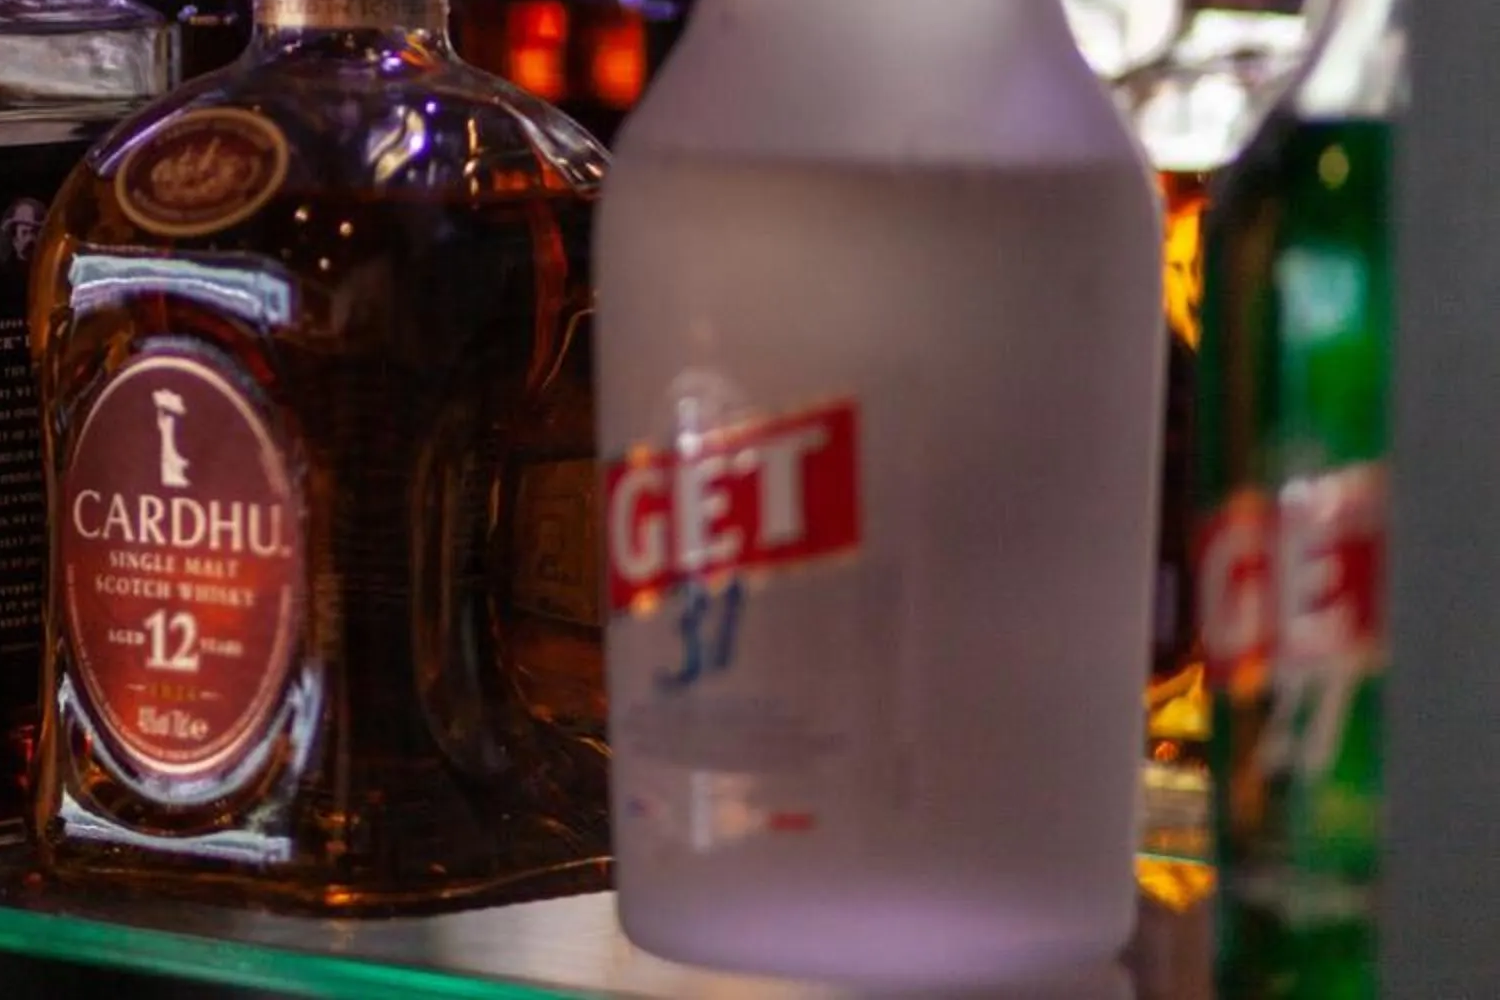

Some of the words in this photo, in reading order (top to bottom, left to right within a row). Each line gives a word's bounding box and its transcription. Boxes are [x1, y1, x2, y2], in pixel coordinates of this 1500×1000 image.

[73, 489, 283, 557] CARDHU
[612, 423, 831, 581] GET
[95, 574, 171, 599] SCOTCH
[108, 550, 175, 573] SINGLE
[184, 556, 239, 579] MALT
[144, 608, 199, 672] 12
